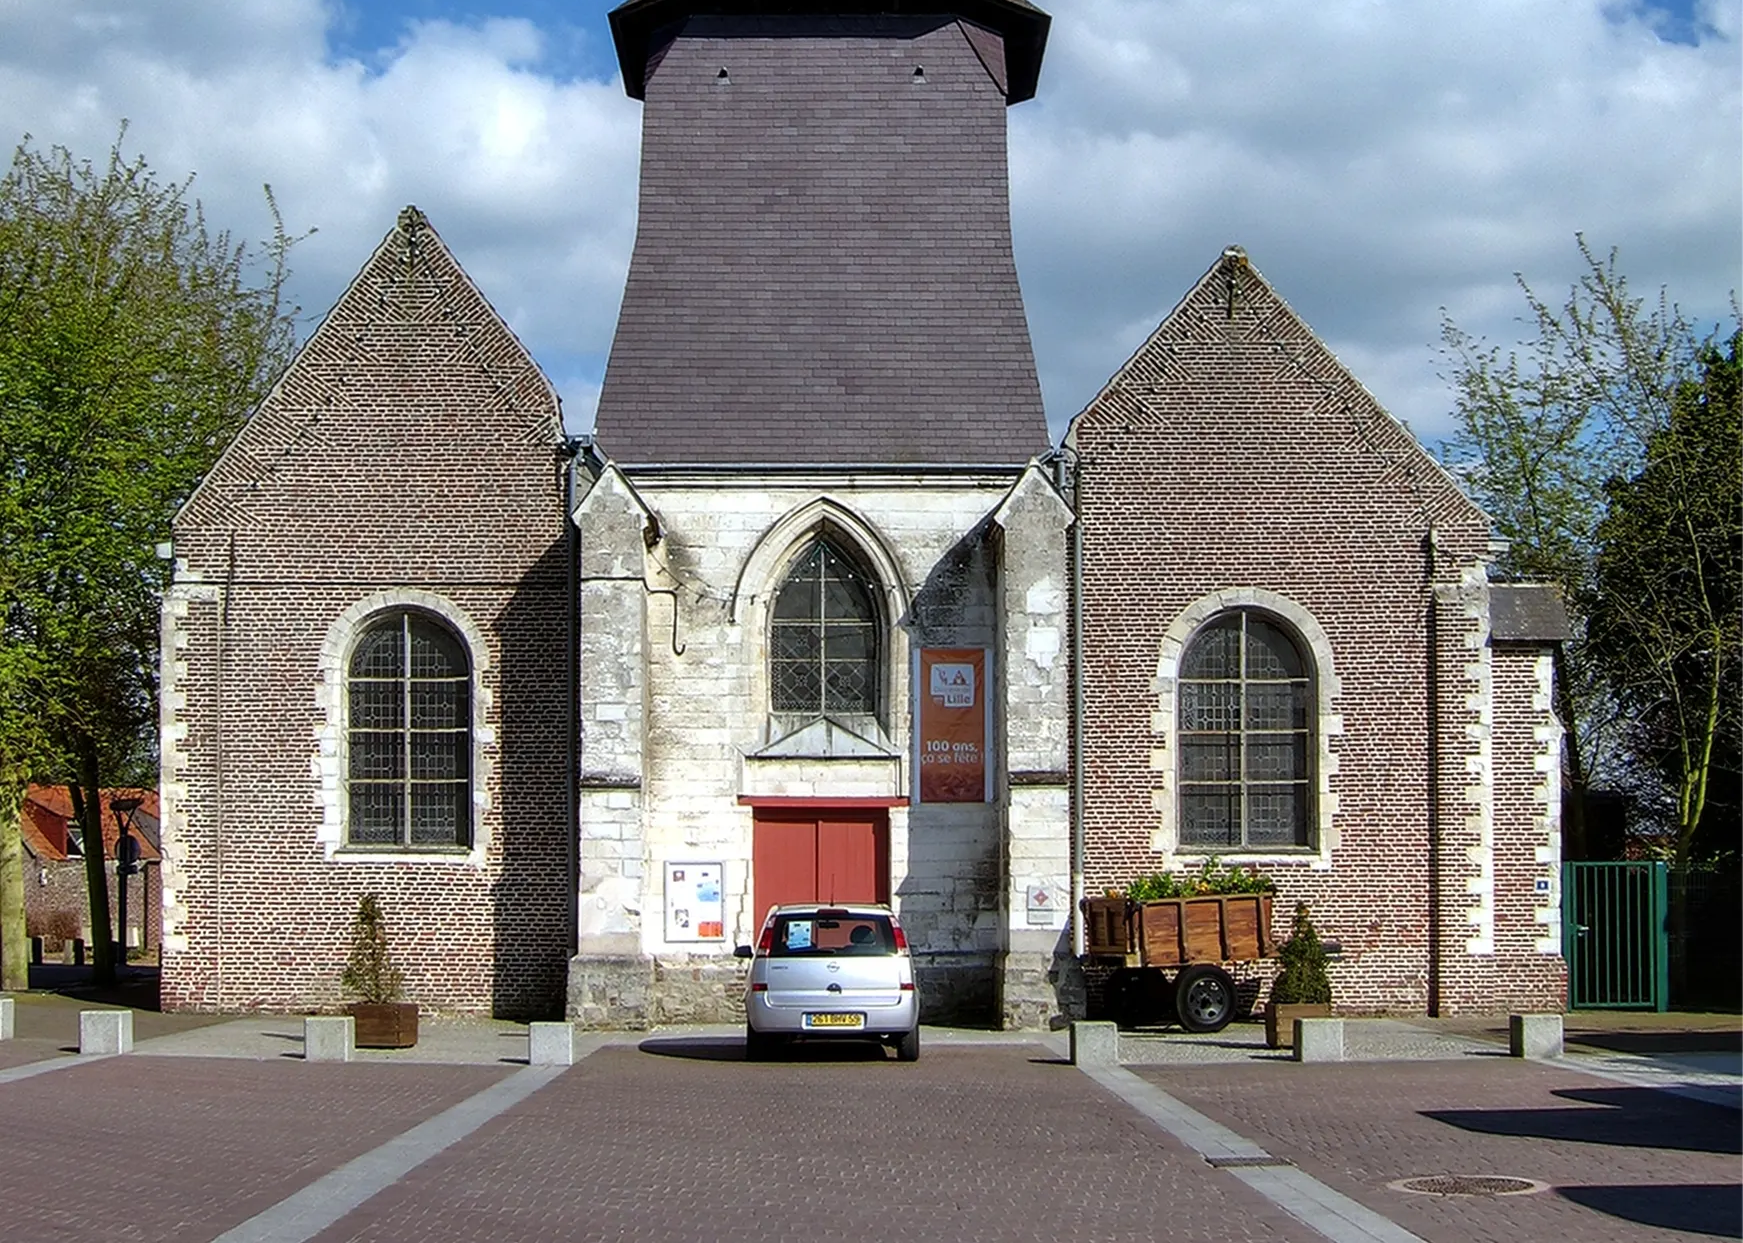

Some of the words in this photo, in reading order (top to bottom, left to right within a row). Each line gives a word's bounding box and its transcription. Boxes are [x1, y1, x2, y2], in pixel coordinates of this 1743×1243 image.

[947, 693, 970, 704] Lille
[926, 740, 950, 752] 100
[952, 742, 978, 752] ans,
[937, 753, 952, 764] se
